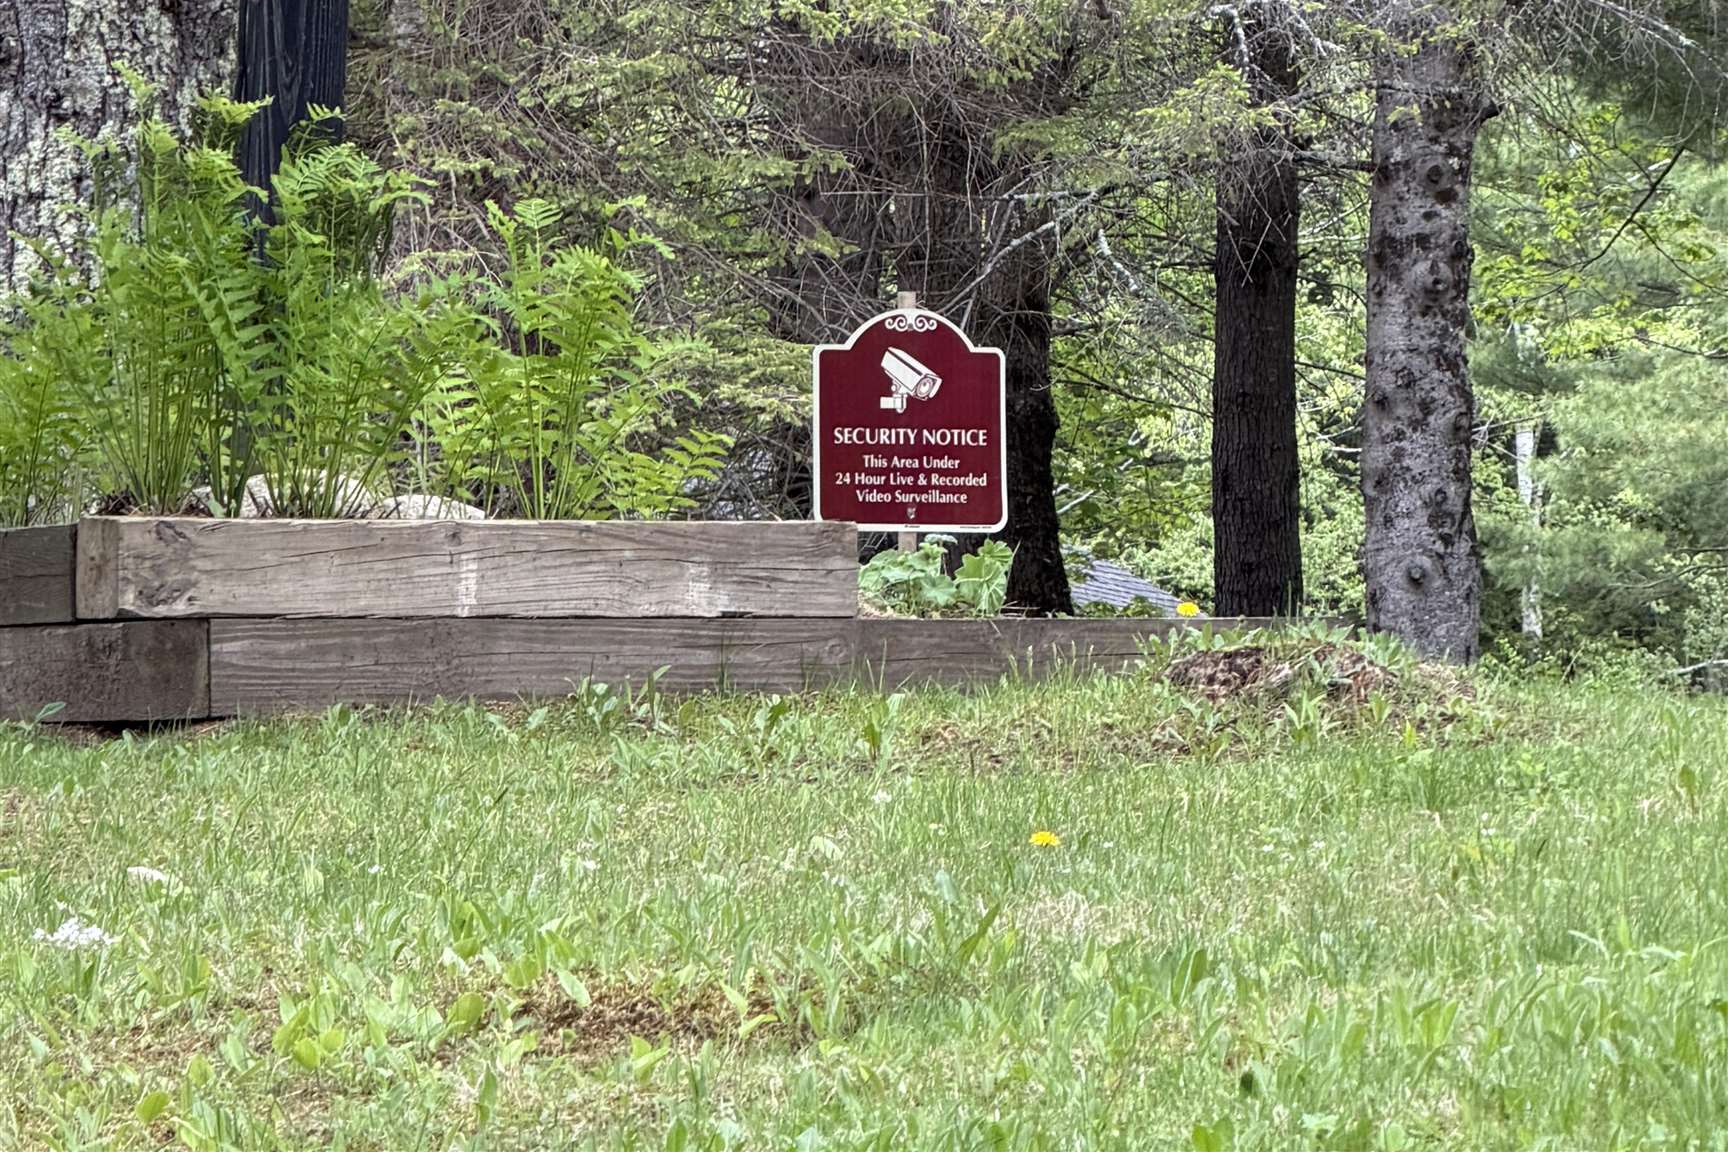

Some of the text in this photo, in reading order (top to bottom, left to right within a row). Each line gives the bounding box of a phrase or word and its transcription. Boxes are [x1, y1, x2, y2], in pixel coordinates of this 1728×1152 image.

[833, 427, 987, 446] SECURITY NOTICE
[863, 454, 960, 469] This Area Under
[835, 472, 987, 487] 24 Hour Live & Recorded
[856, 489, 968, 504] Video Surveillance
